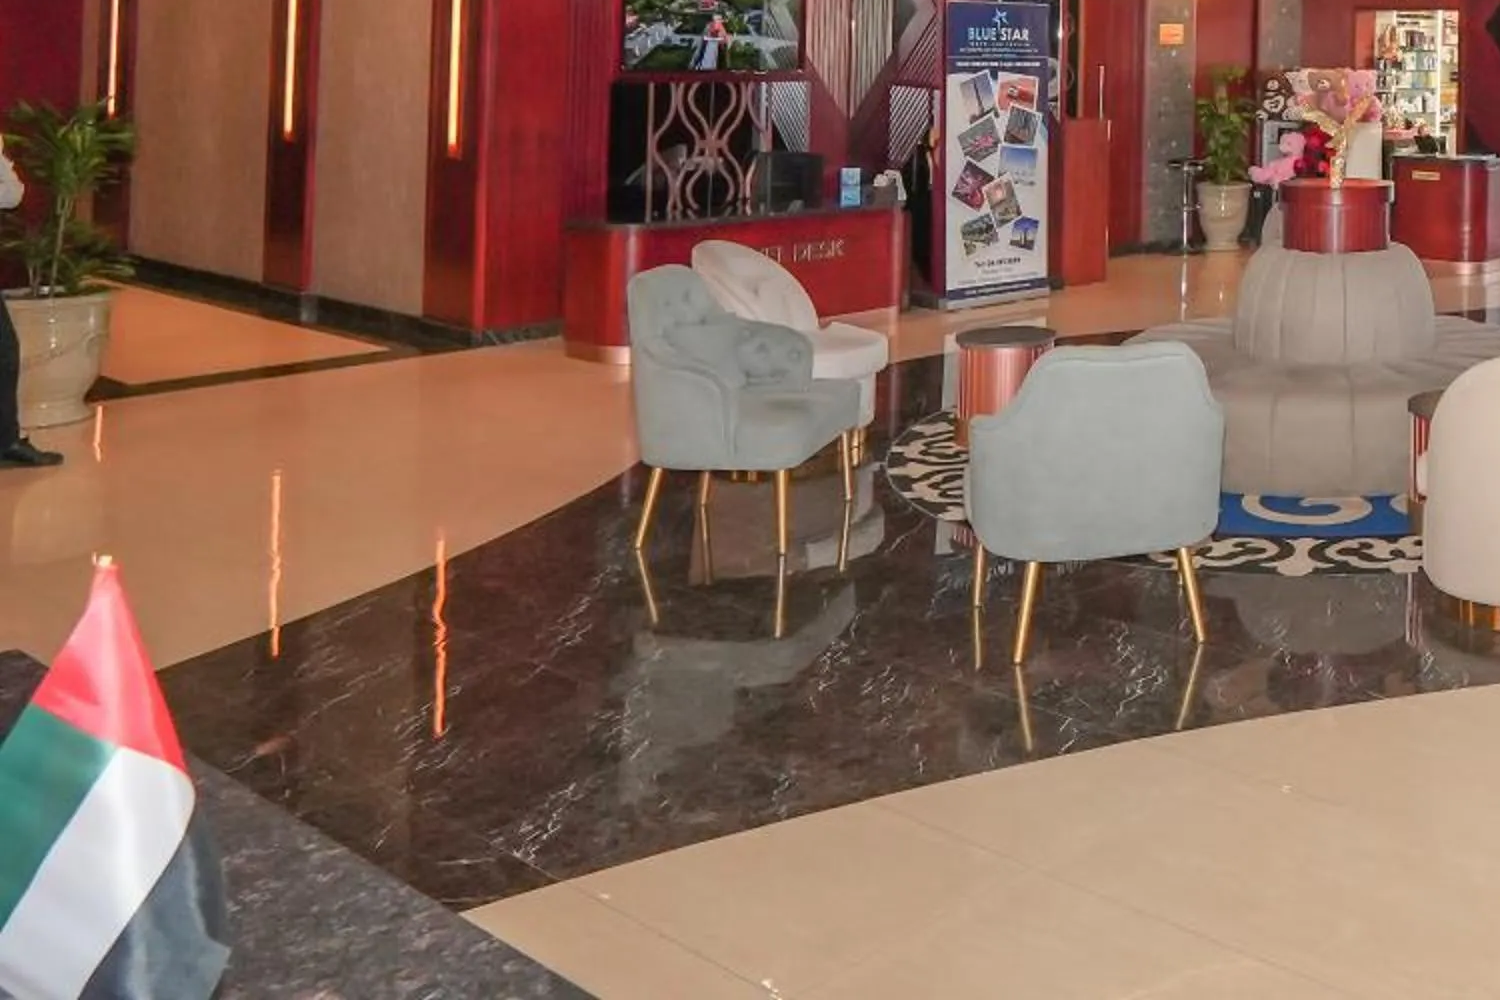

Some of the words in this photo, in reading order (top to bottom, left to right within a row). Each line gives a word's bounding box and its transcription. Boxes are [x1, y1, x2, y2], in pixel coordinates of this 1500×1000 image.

[967, 27, 997, 41] BLUE
[1000, 27, 1029, 41] STAR
[792, 239, 845, 263] DESK
